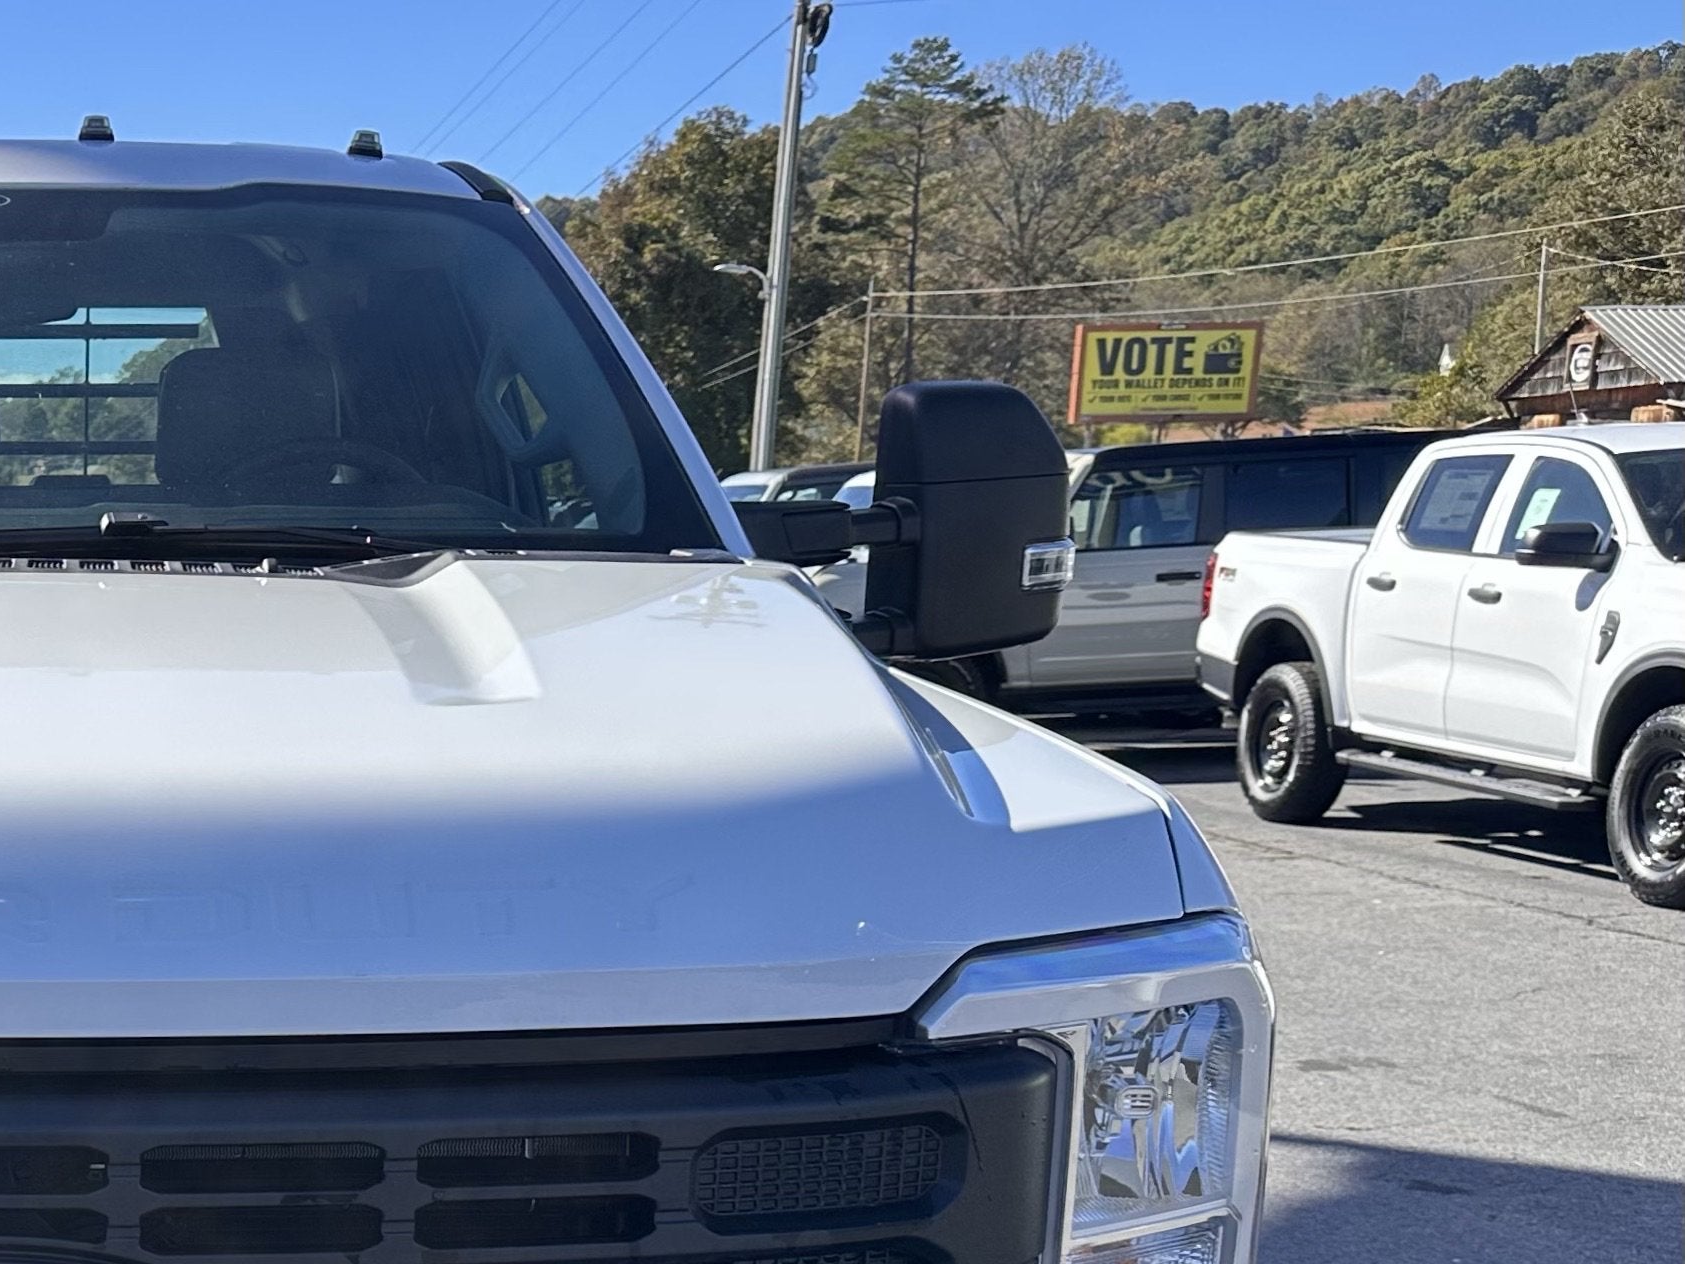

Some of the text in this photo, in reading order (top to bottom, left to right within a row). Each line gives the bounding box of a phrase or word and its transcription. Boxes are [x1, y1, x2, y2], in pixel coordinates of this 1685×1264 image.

[1096, 336, 1196, 377] VOTE
[1091, 379, 1120, 389] YOUR
[1124, 378, 1164, 389] WALLET
[1168, 377, 1213, 388] DEPENDS
[1216, 377, 1229, 388] ON
